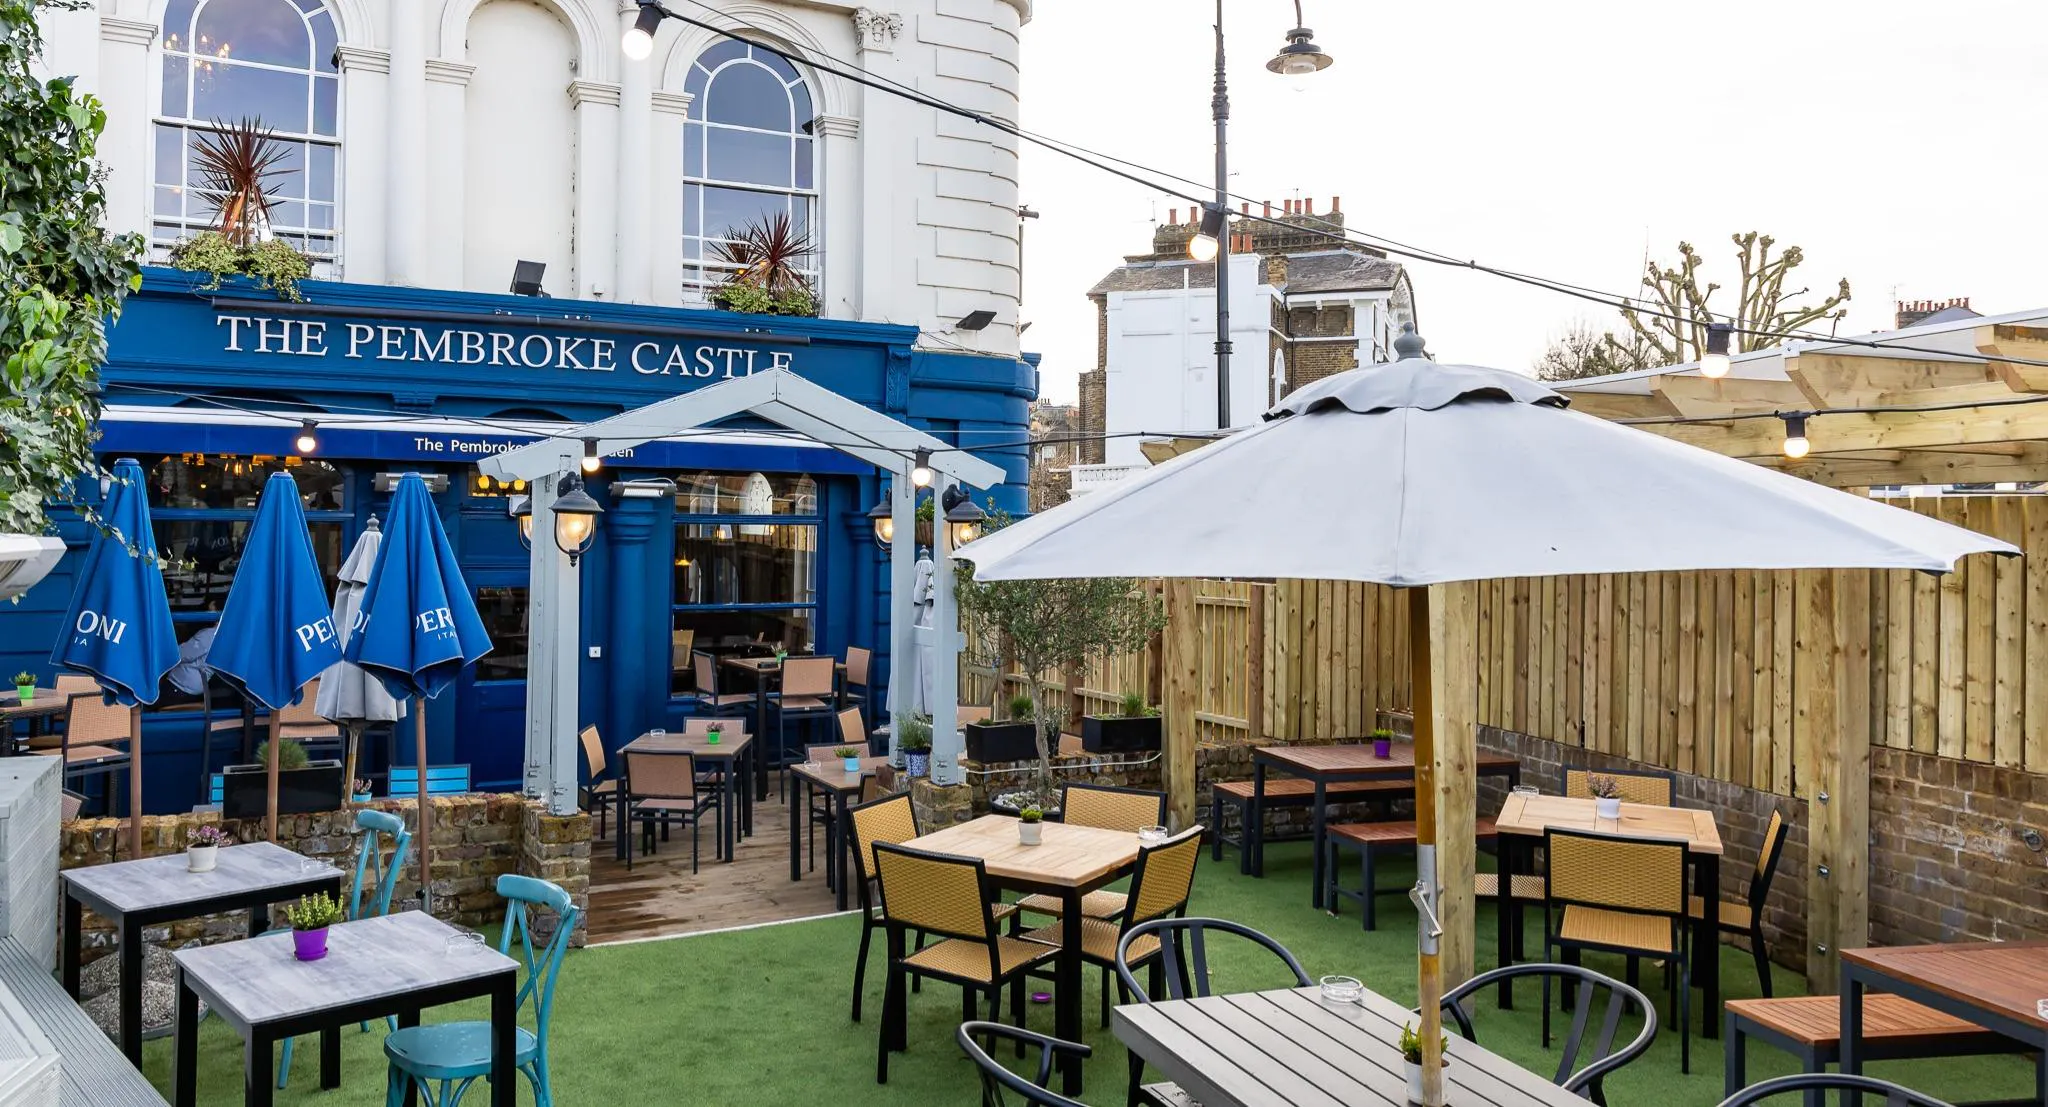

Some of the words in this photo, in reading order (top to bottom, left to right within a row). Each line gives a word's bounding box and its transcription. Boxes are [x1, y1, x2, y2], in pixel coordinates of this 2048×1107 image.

[216, 314, 329, 357] THE
[344, 322, 617, 372] PEMBROKE
[414, 437, 444, 452] The
